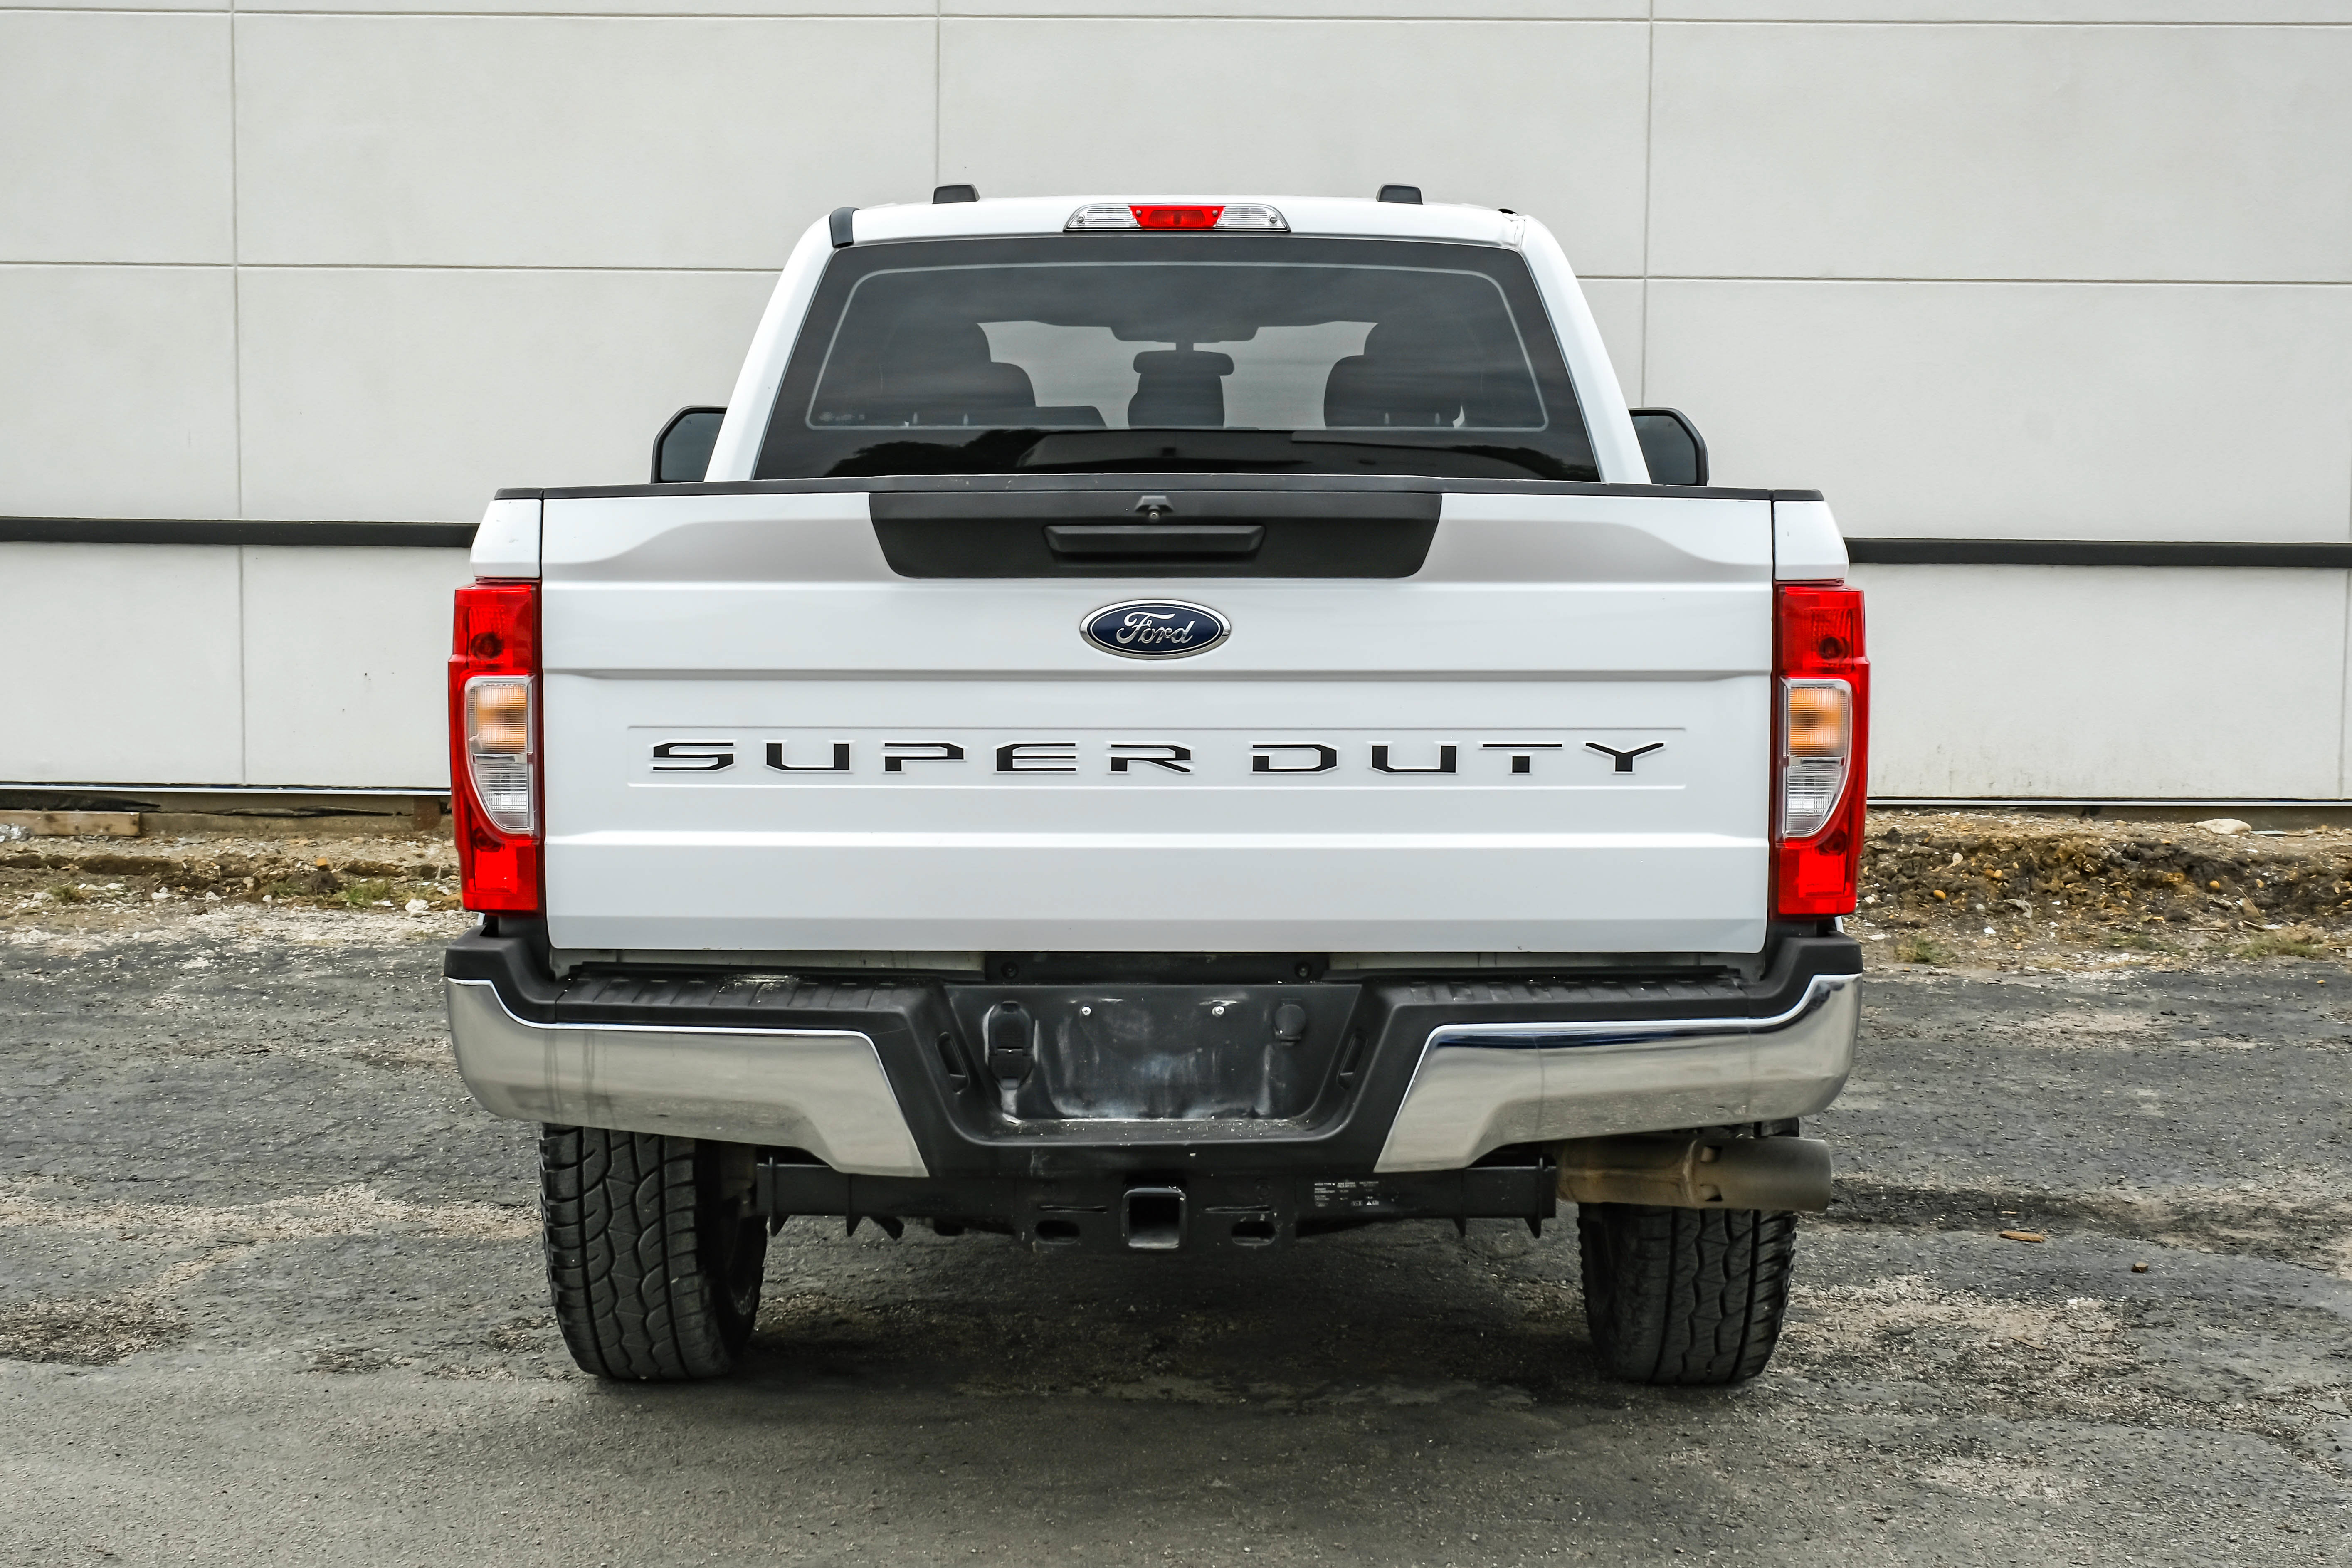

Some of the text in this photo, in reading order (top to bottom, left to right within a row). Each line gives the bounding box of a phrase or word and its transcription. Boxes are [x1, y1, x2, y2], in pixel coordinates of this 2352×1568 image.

[1116, 612, 1195, 644] Ford
[652, 741, 1665, 773] SUPER DUTY
